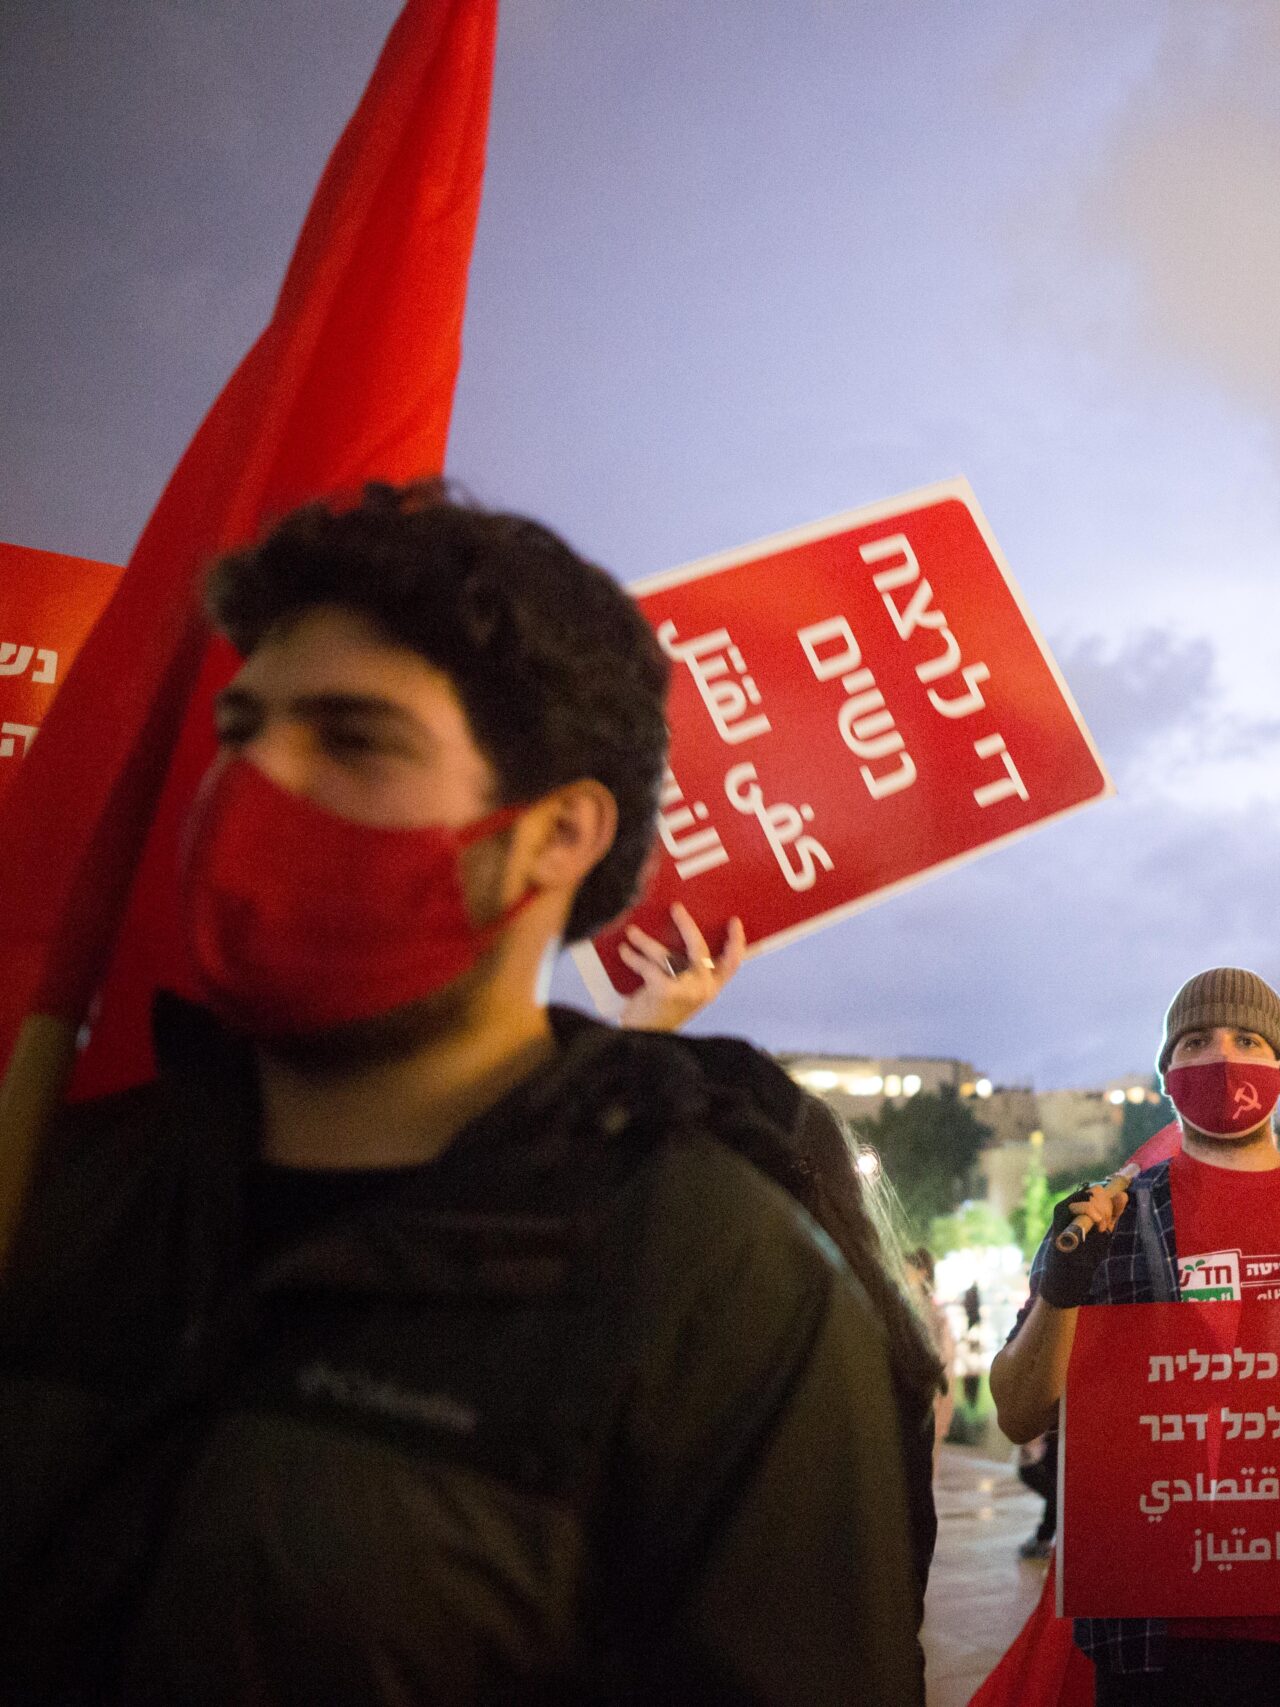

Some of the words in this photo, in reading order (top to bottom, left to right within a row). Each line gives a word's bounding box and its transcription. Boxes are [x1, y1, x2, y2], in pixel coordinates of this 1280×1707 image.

[858, 532, 991, 719] לרצח
[657, 619, 772, 744] لقتل
[798, 614, 917, 801] נשים
[973, 732, 1030, 808] די
[1147, 1348, 1279, 1383] כלכלית
[1139, 1412, 1208, 1442] דבר
